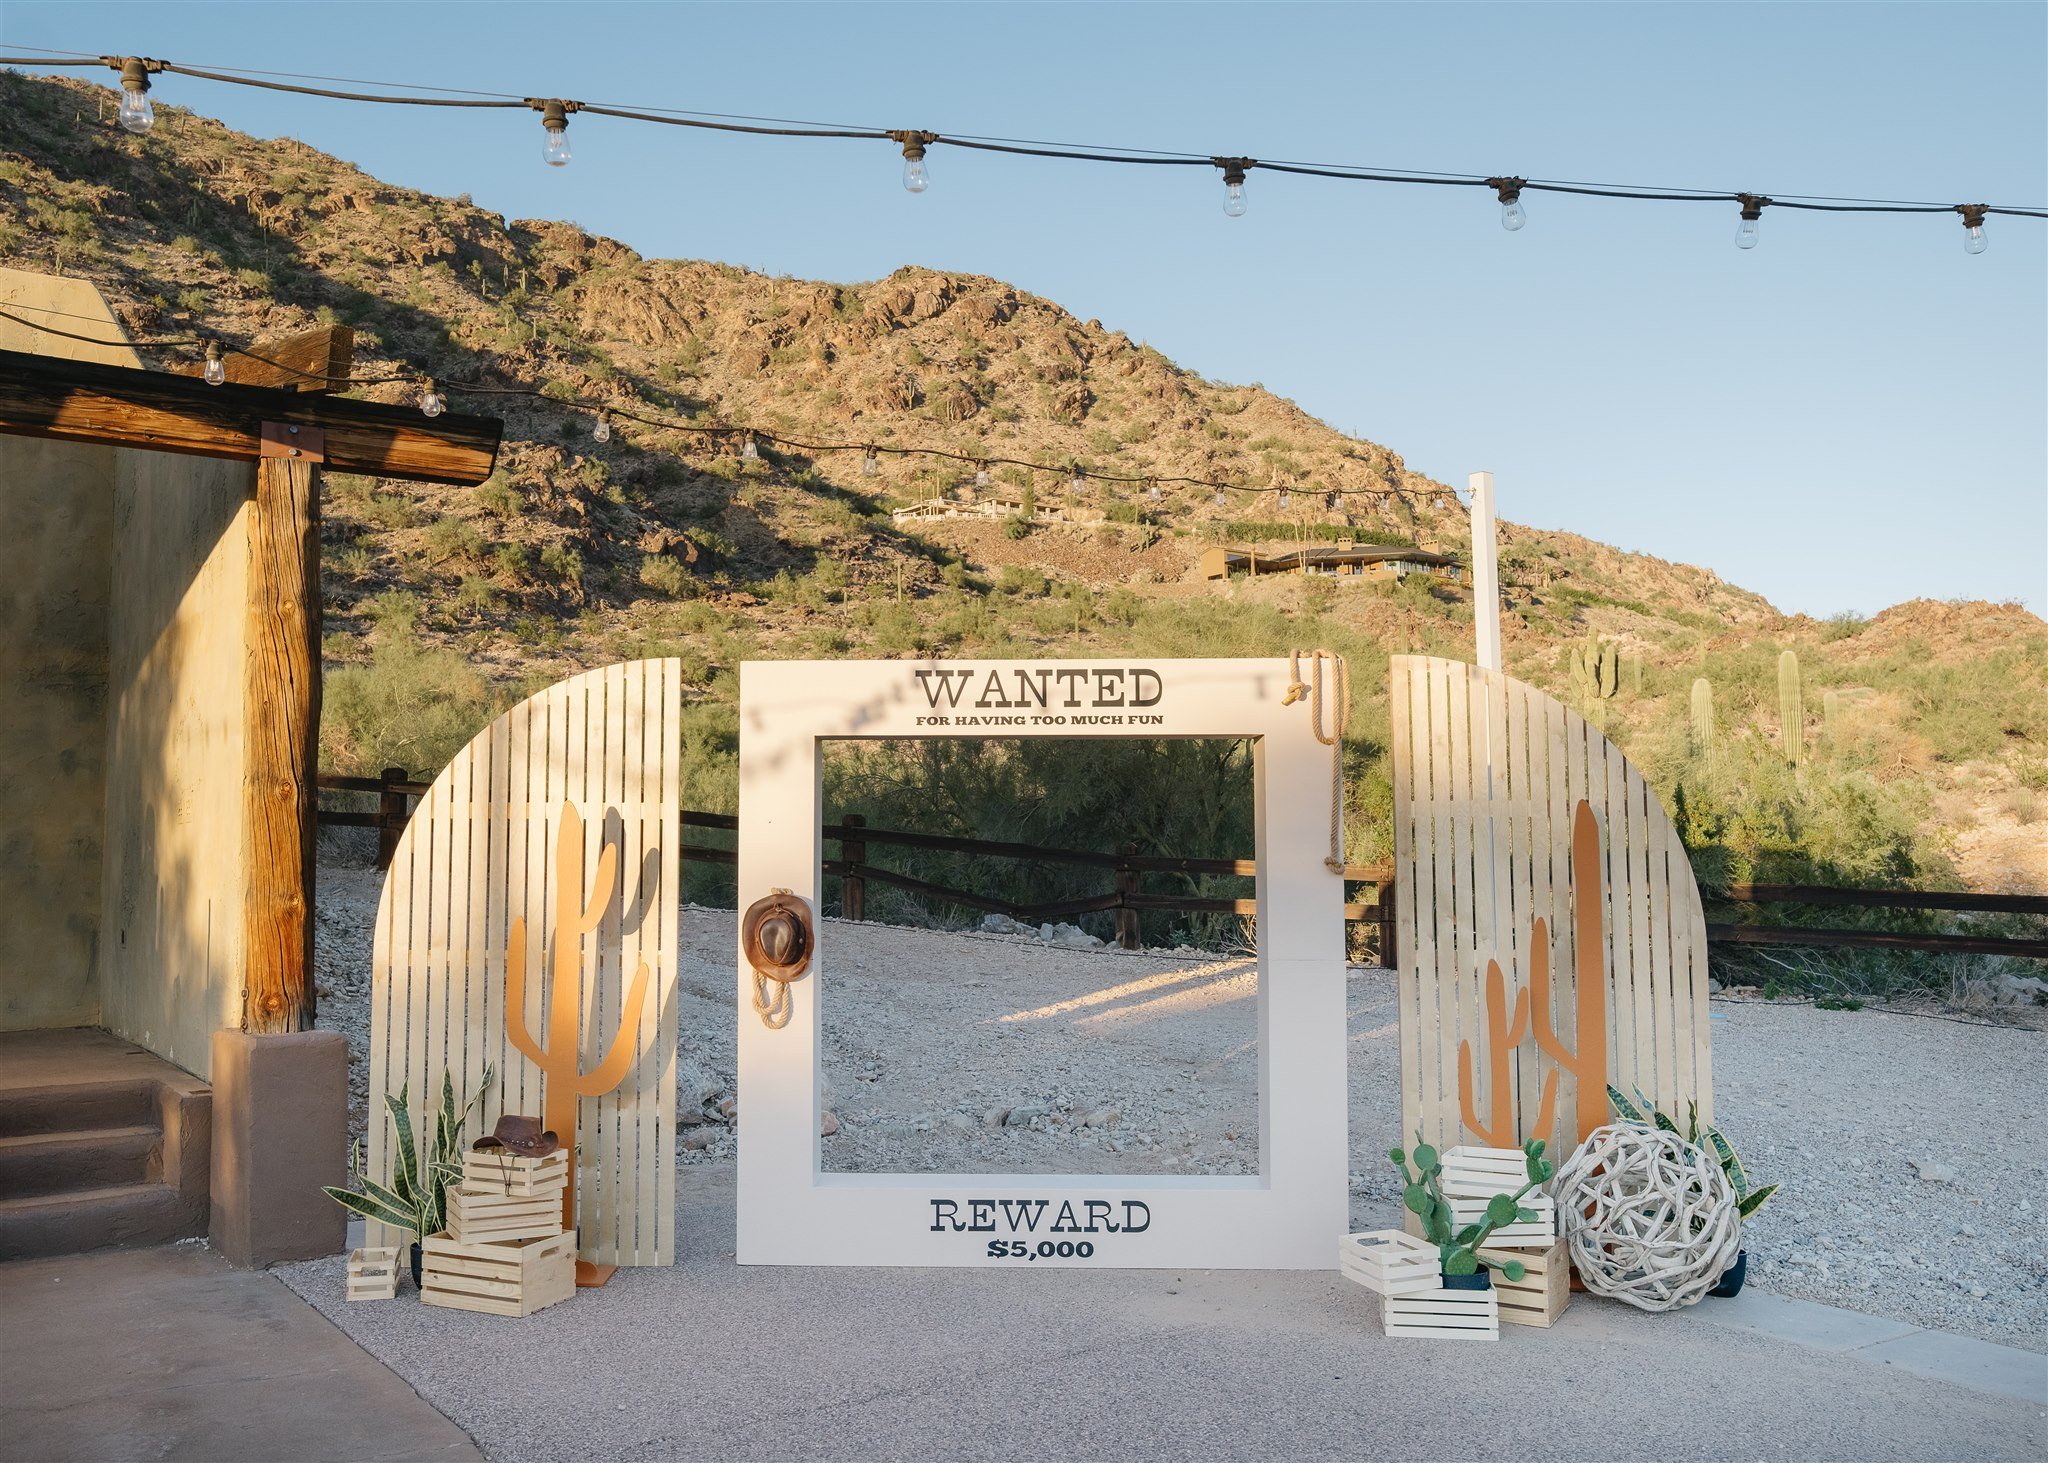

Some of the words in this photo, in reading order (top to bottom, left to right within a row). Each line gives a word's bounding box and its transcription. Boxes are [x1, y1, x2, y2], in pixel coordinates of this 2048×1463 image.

[915, 669, 1163, 708] WANTED
[916, 715, 951, 726] FOR
[955, 715, 1026, 726] HAVING
[1031, 715, 1067, 726] TOO
[1071, 715, 1123, 726] MUCH
[1127, 715, 1164, 726] FUN
[930, 1199, 1151, 1233] REWARD
[987, 1239, 1094, 1260] $5,000
